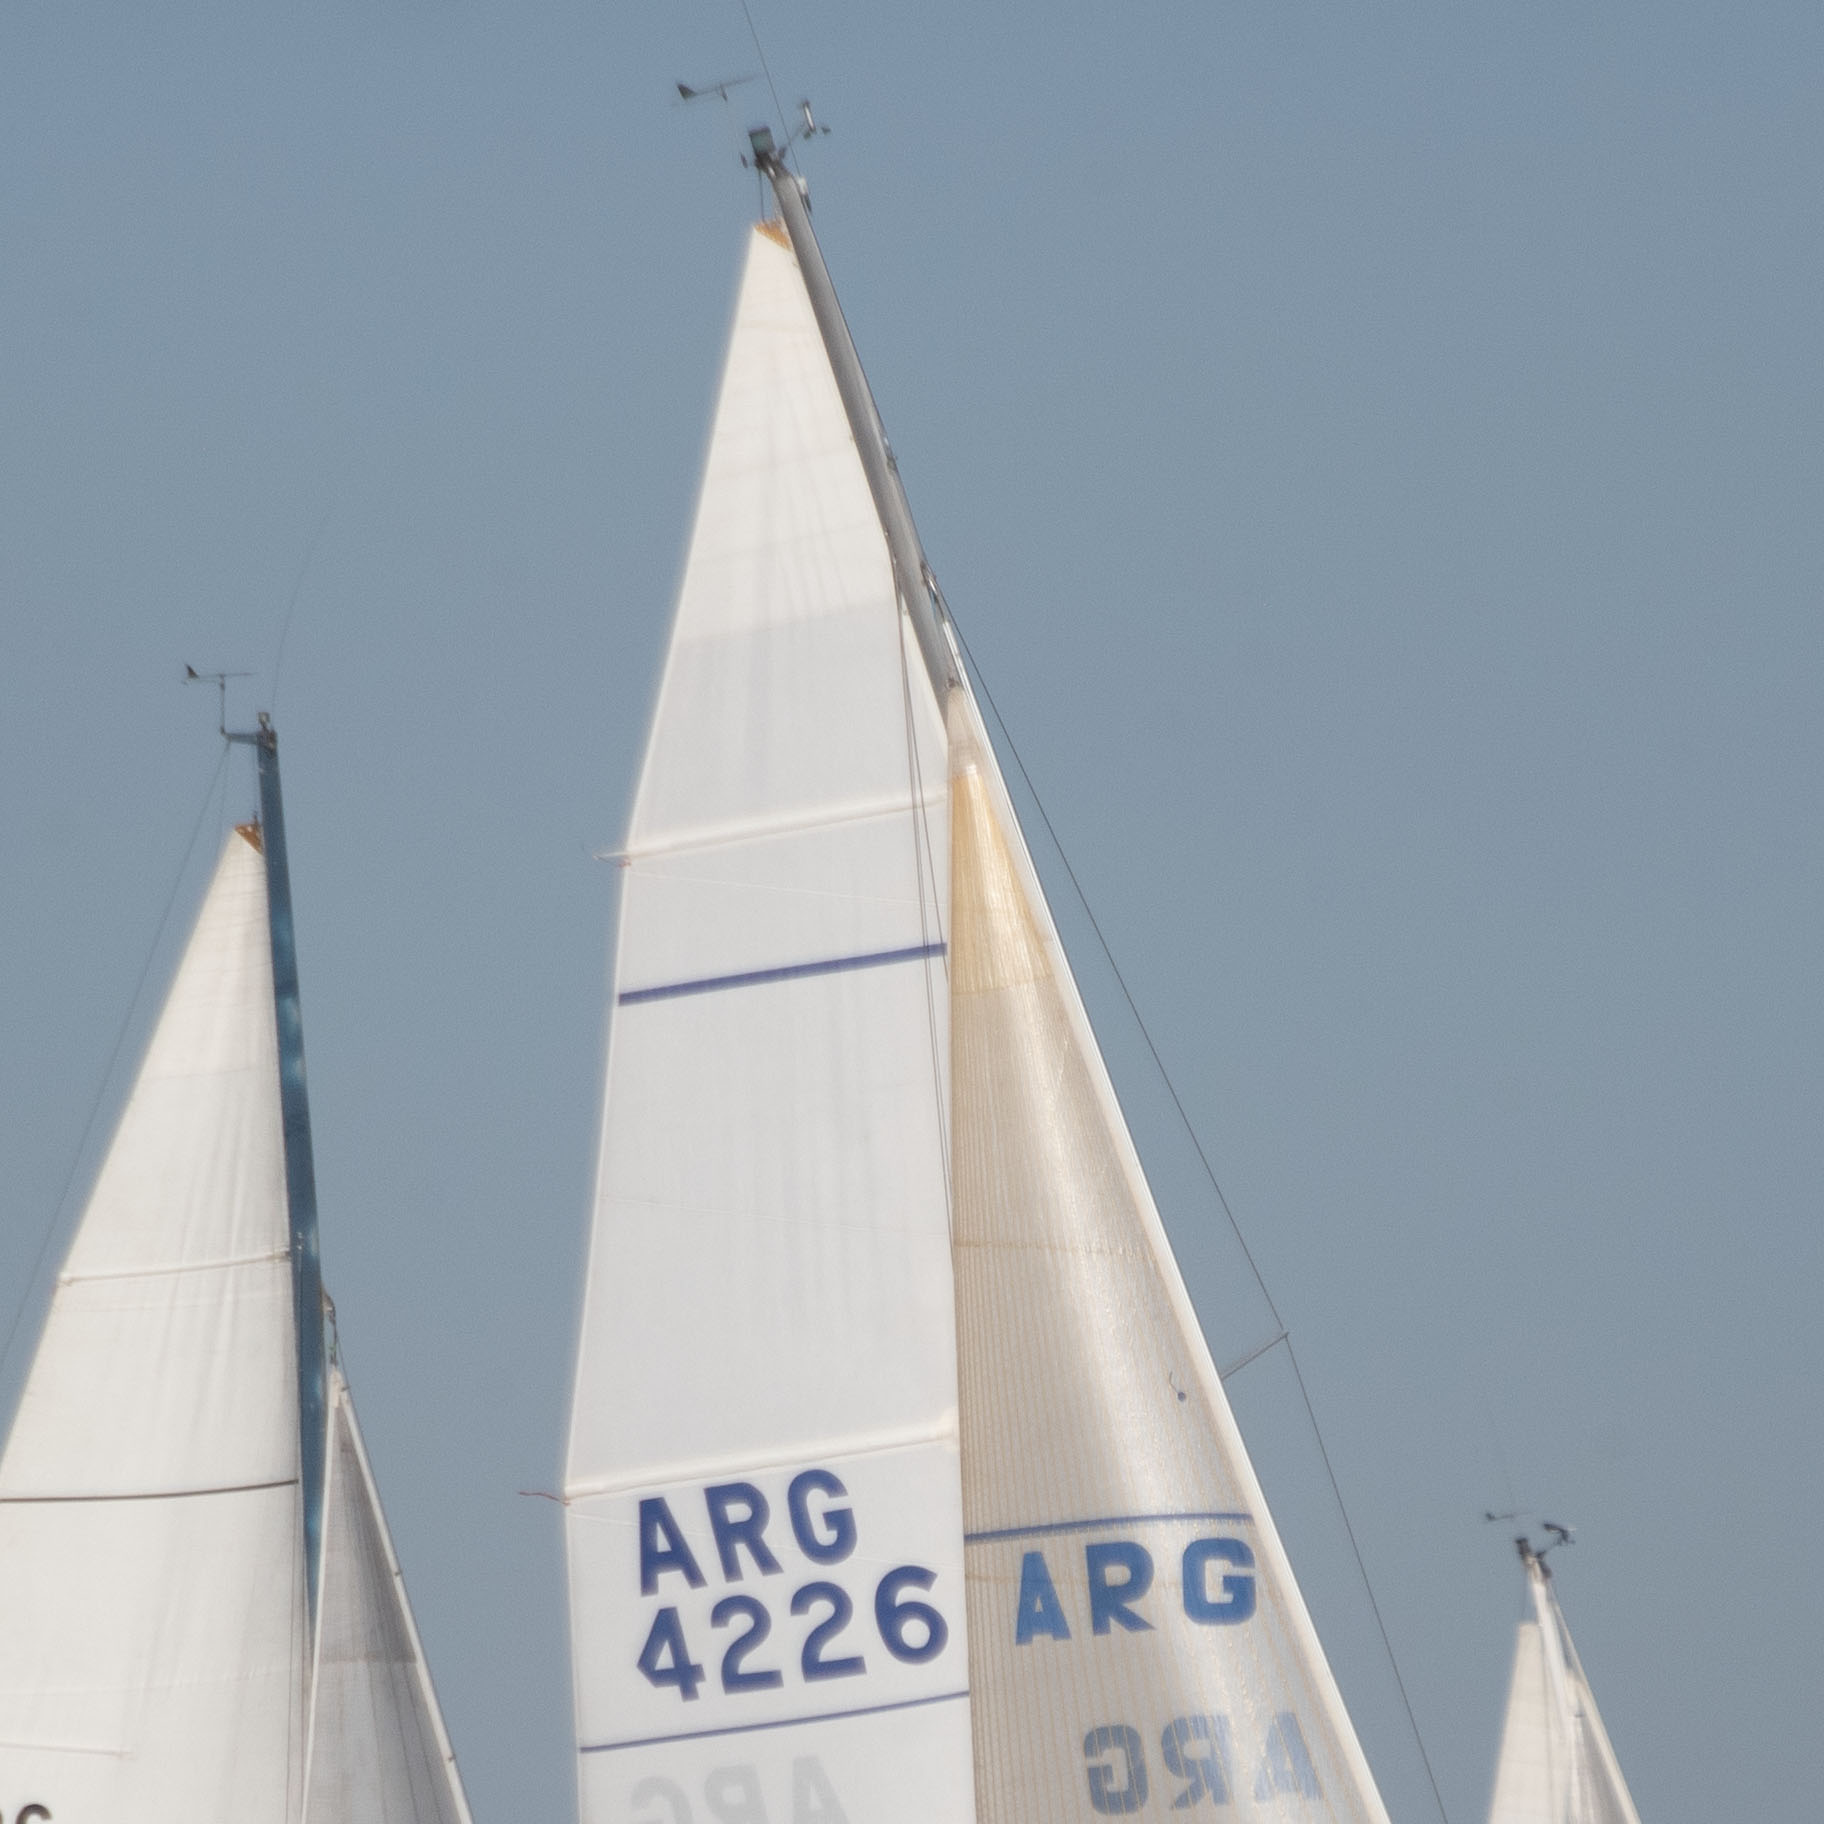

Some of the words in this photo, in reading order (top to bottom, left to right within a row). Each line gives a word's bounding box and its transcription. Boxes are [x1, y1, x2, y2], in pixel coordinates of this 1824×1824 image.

[638, 1468, 858, 1597] ARG
[1015, 1538, 1257, 1645] ARG
[636, 1565, 949, 1702] 4226
